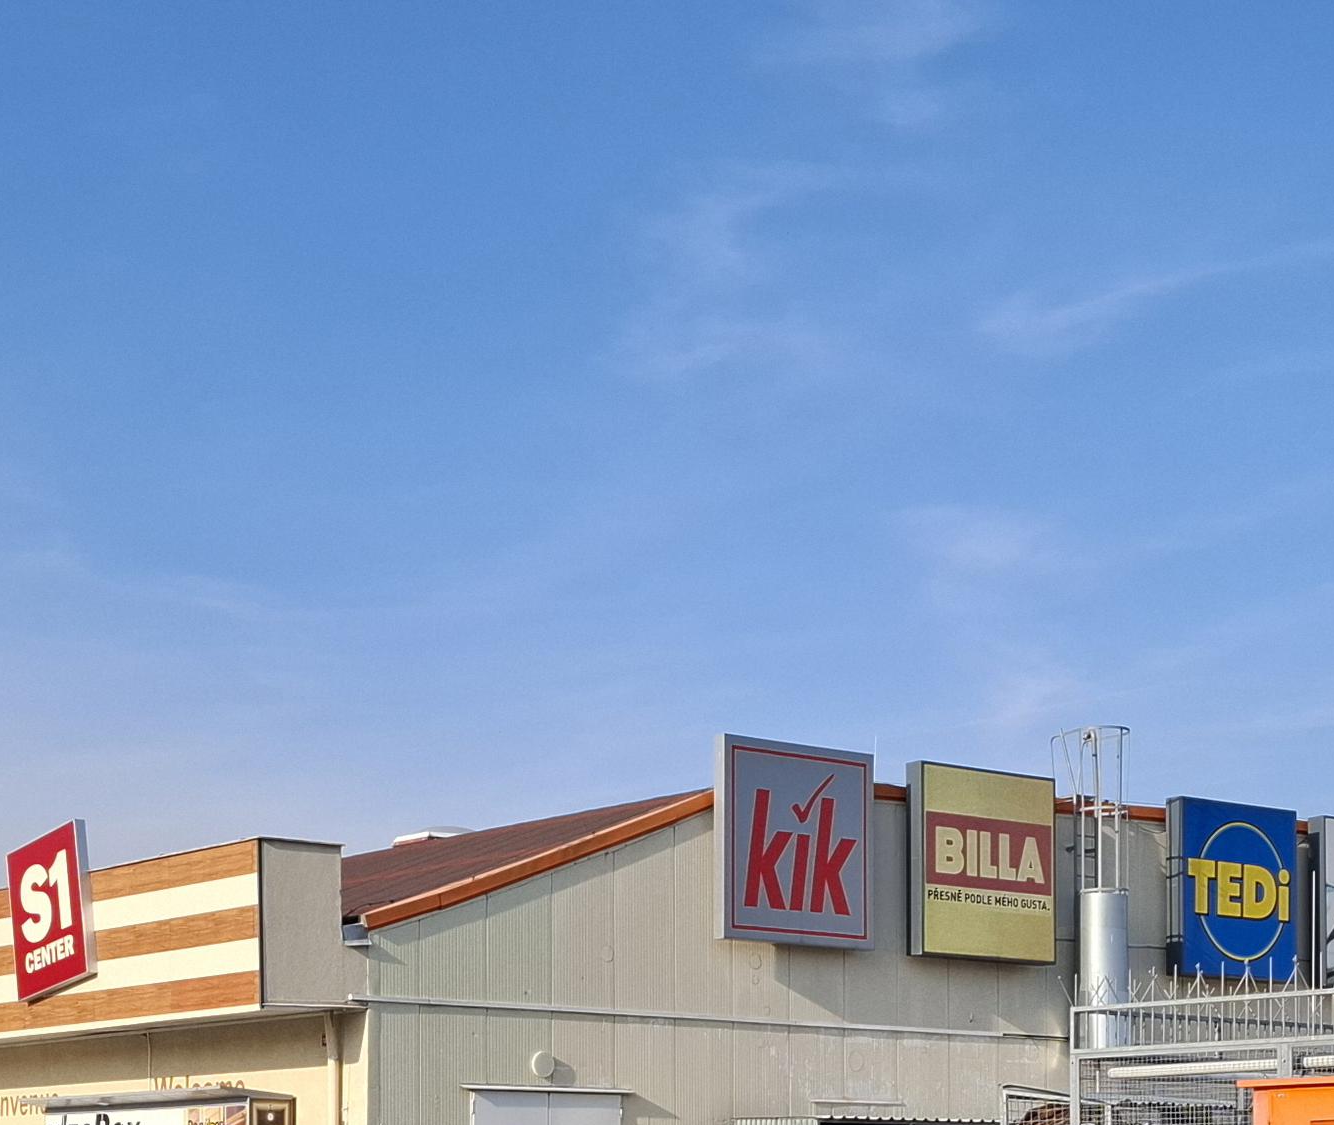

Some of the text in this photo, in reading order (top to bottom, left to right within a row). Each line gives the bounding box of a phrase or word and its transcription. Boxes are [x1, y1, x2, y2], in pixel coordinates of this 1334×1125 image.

[935, 826, 1045, 884] BILLA
[20, 848, 72, 944] S1
[964, 893, 992, 906] PODLE
[994, 893, 1019, 908] MÉHO
[1020, 898, 1051, 911] GUSTA.
[1188, 858, 1290, 922] TEDi
[25, 934, 75, 974] CENTER
